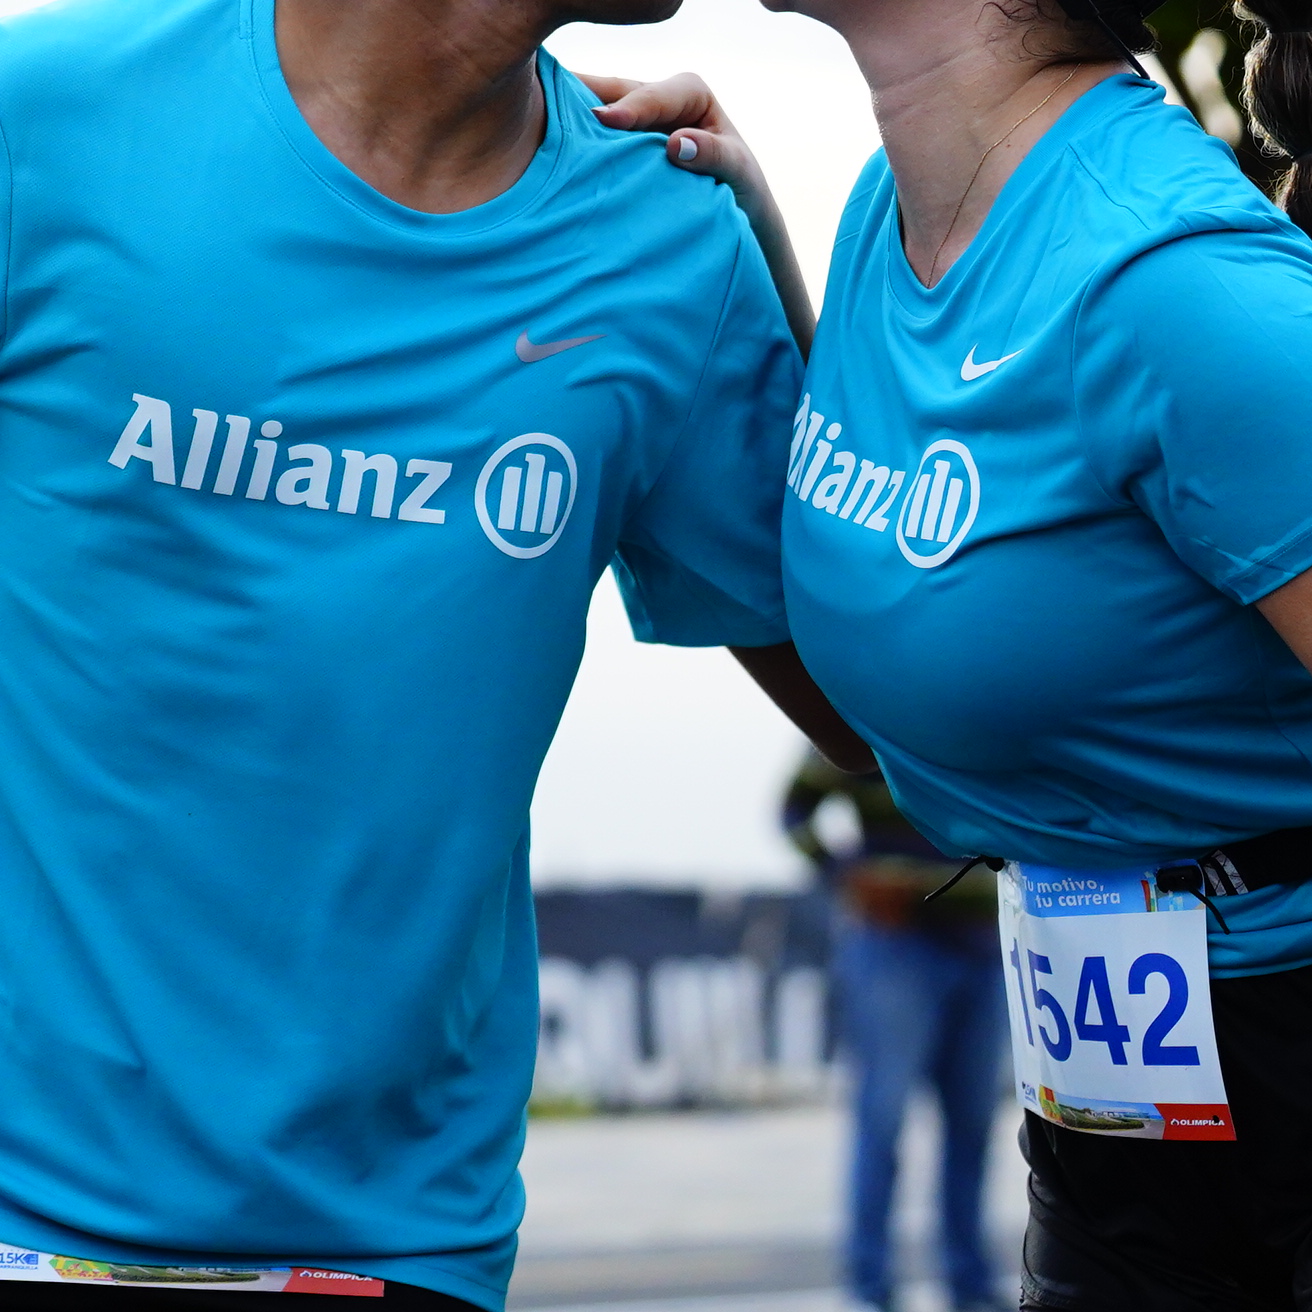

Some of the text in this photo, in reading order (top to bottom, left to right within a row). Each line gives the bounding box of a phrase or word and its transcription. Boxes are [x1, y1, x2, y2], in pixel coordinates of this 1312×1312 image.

[107, 393, 453, 524] Allianz
[1035, 892, 1121, 908] tu carrera
[1037, 877, 1105, 894] motivo,
[1010, 937, 1200, 1066] 1542
